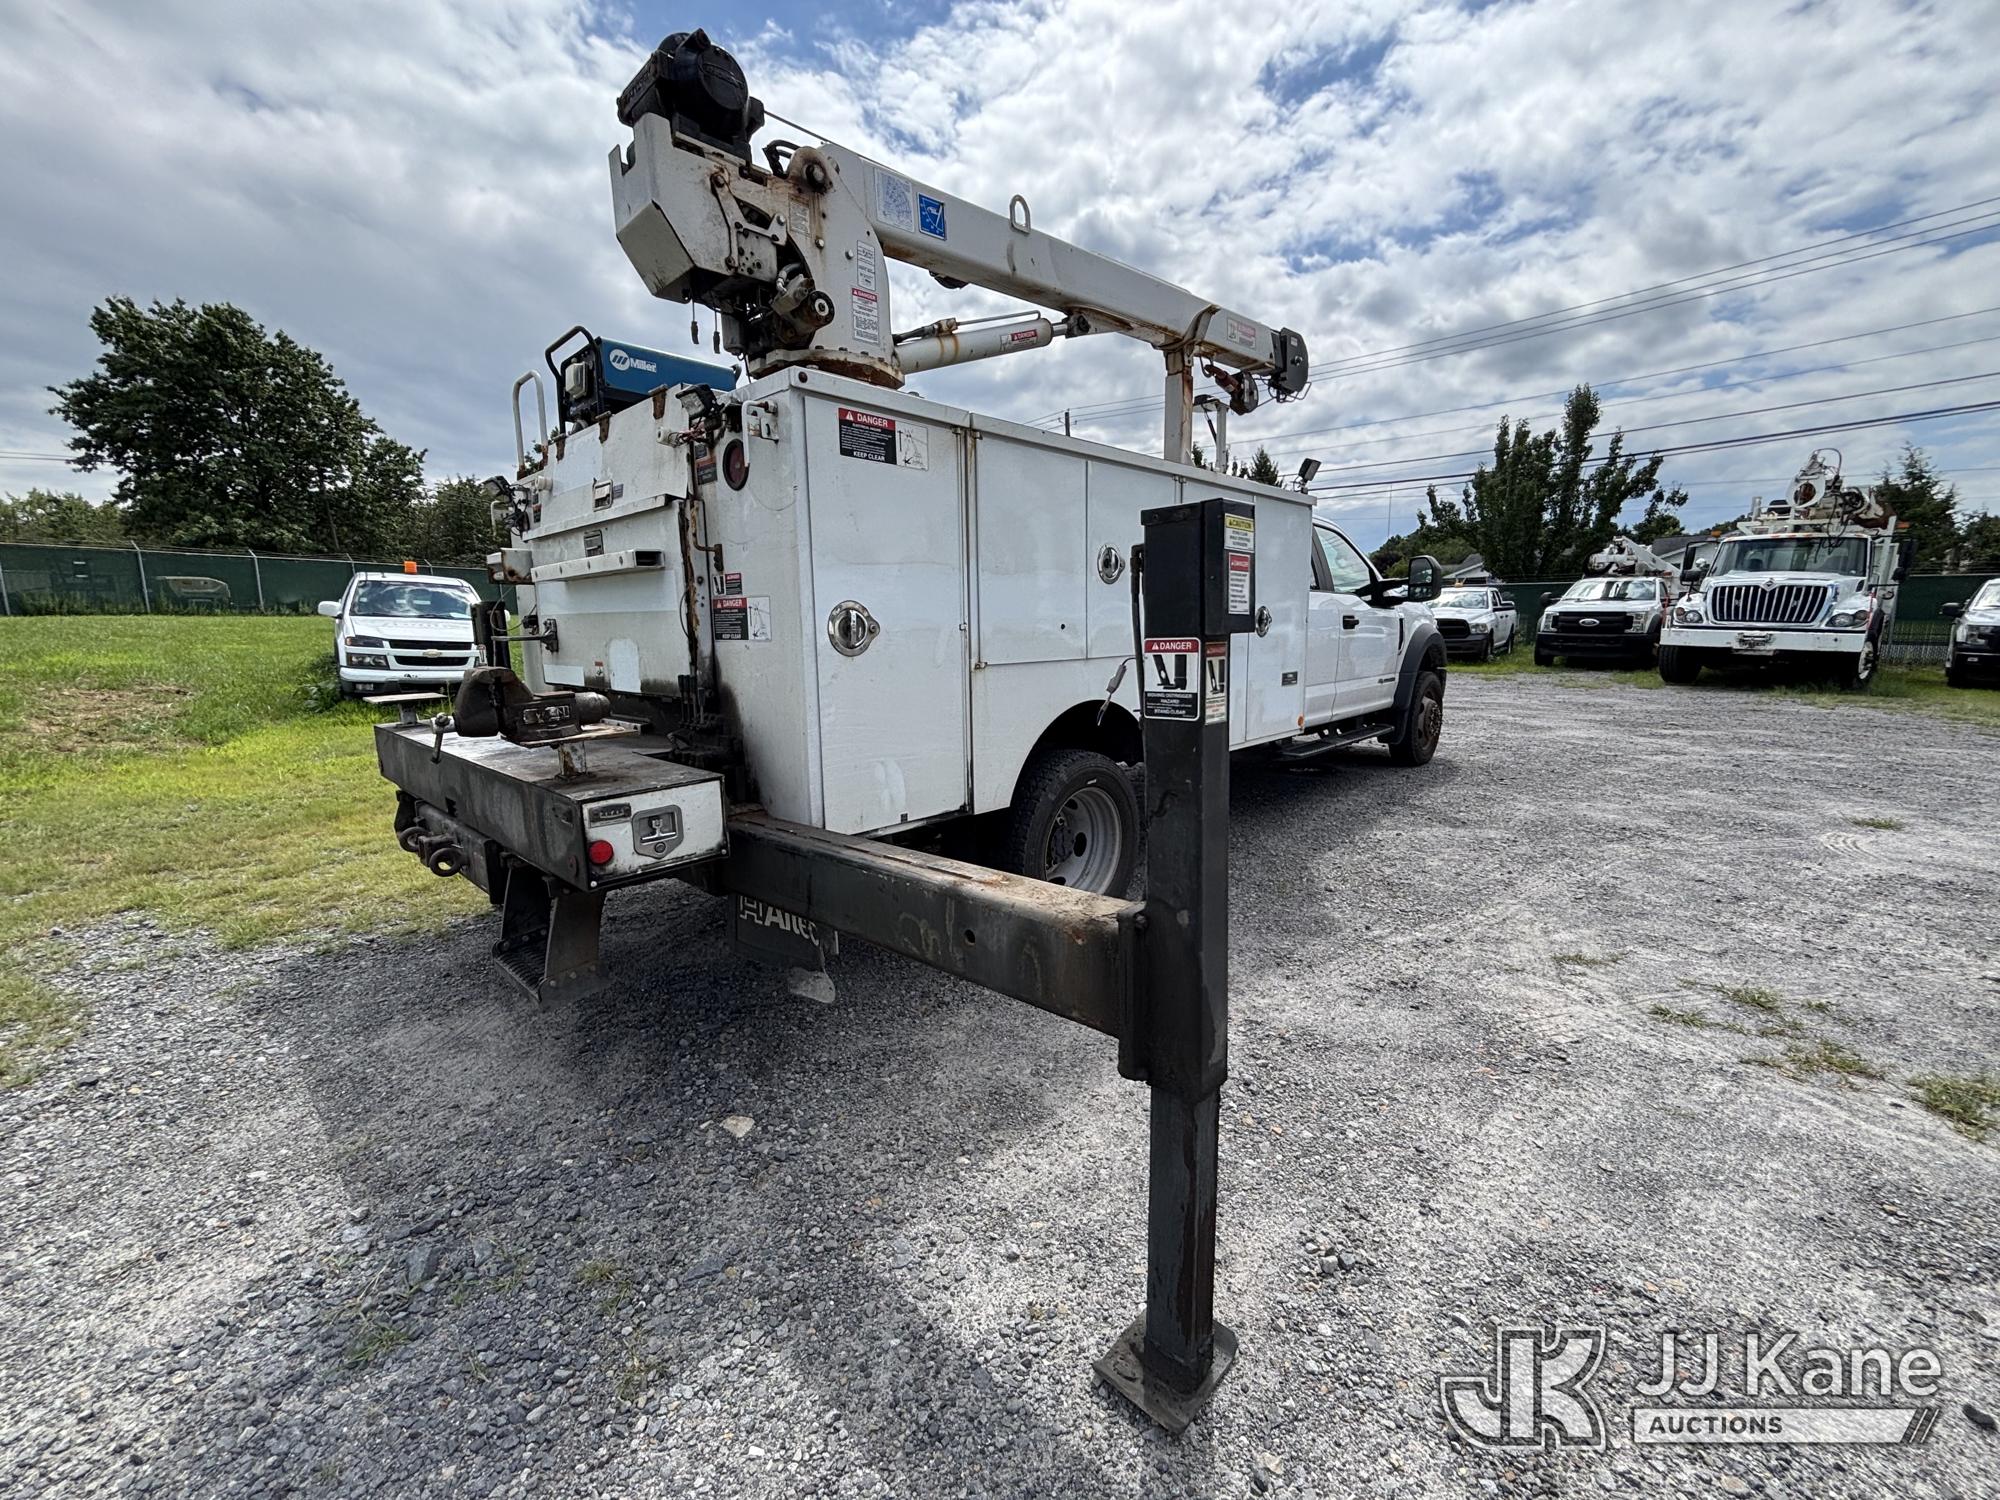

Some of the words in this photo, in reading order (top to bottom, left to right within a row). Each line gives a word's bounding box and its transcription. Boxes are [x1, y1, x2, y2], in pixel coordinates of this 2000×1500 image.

[630, 357, 657, 373] Miller
[857, 413, 888, 428] DANGER
[853, 451, 868, 459] KEEP
[868, 453, 885, 462] CLEAR
[723, 599, 743, 607] DANGER
[1160, 642, 1192, 650] DANGER
